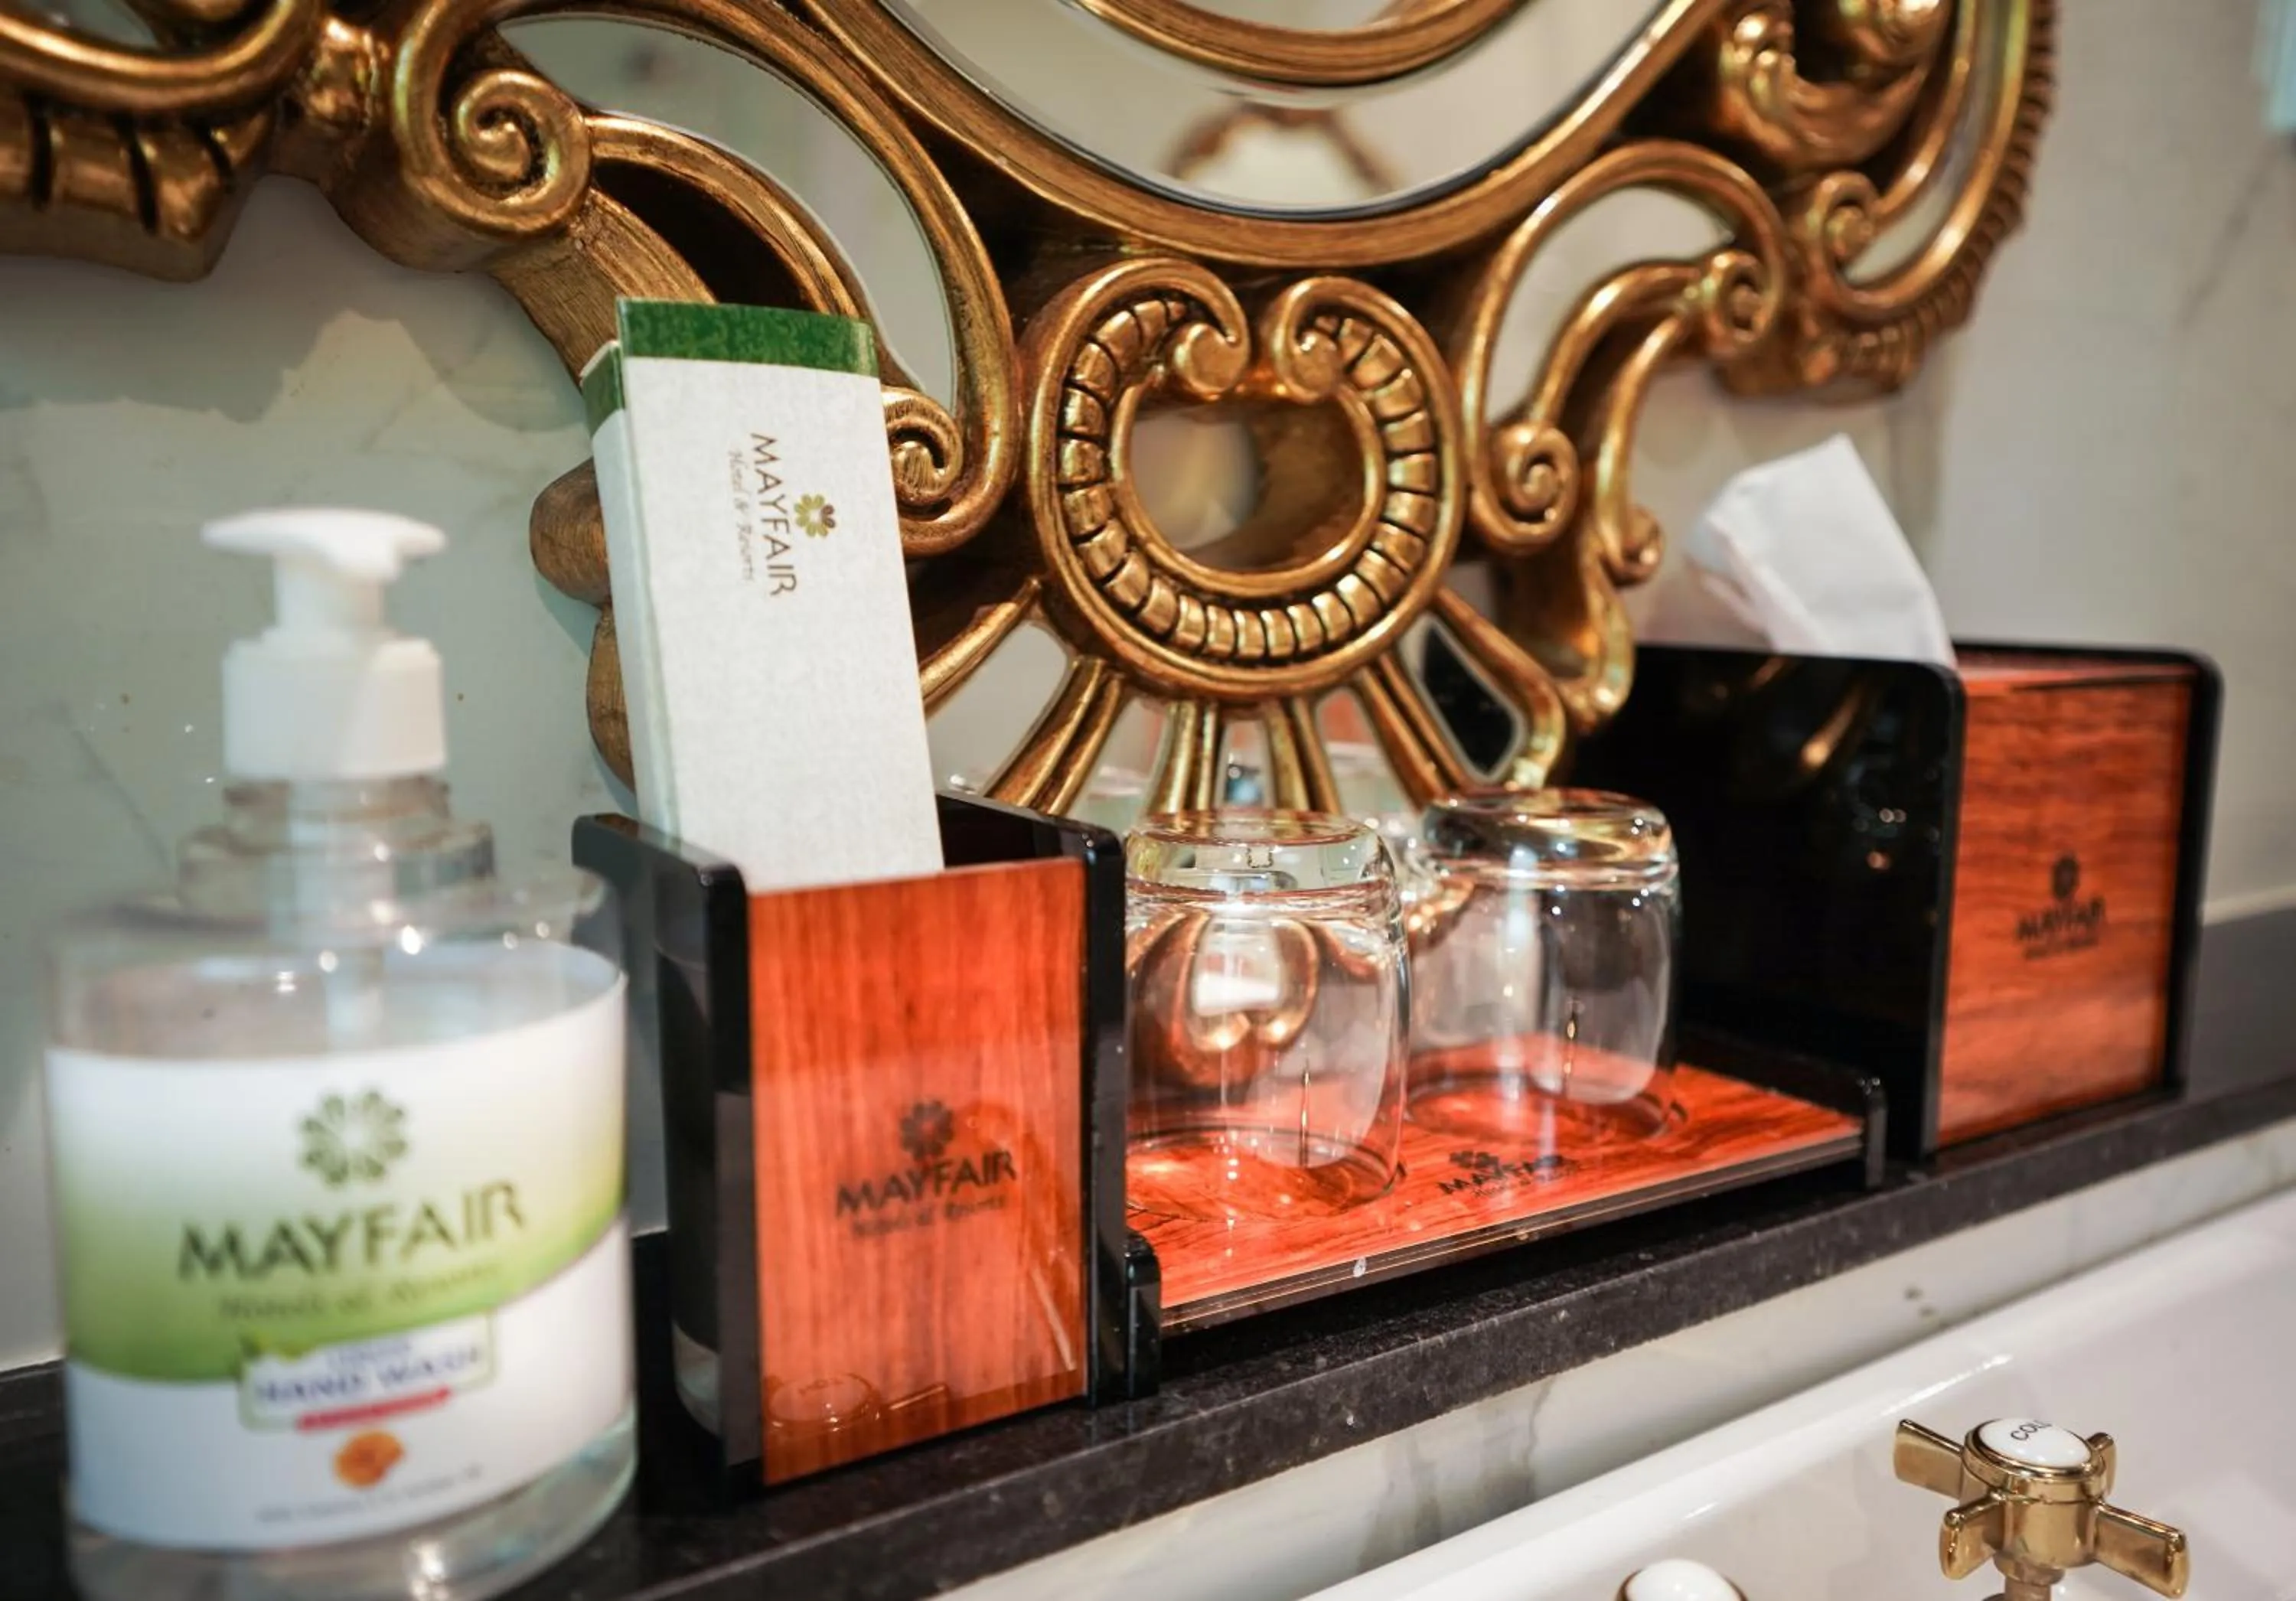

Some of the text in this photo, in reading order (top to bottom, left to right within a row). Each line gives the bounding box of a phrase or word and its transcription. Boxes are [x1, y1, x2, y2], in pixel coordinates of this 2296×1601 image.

[750, 432, 797, 597] MAYFAIR
[175, 1179, 526, 1281] MAYFAIR
[836, 1149, 1016, 1221] MAYFAIR
